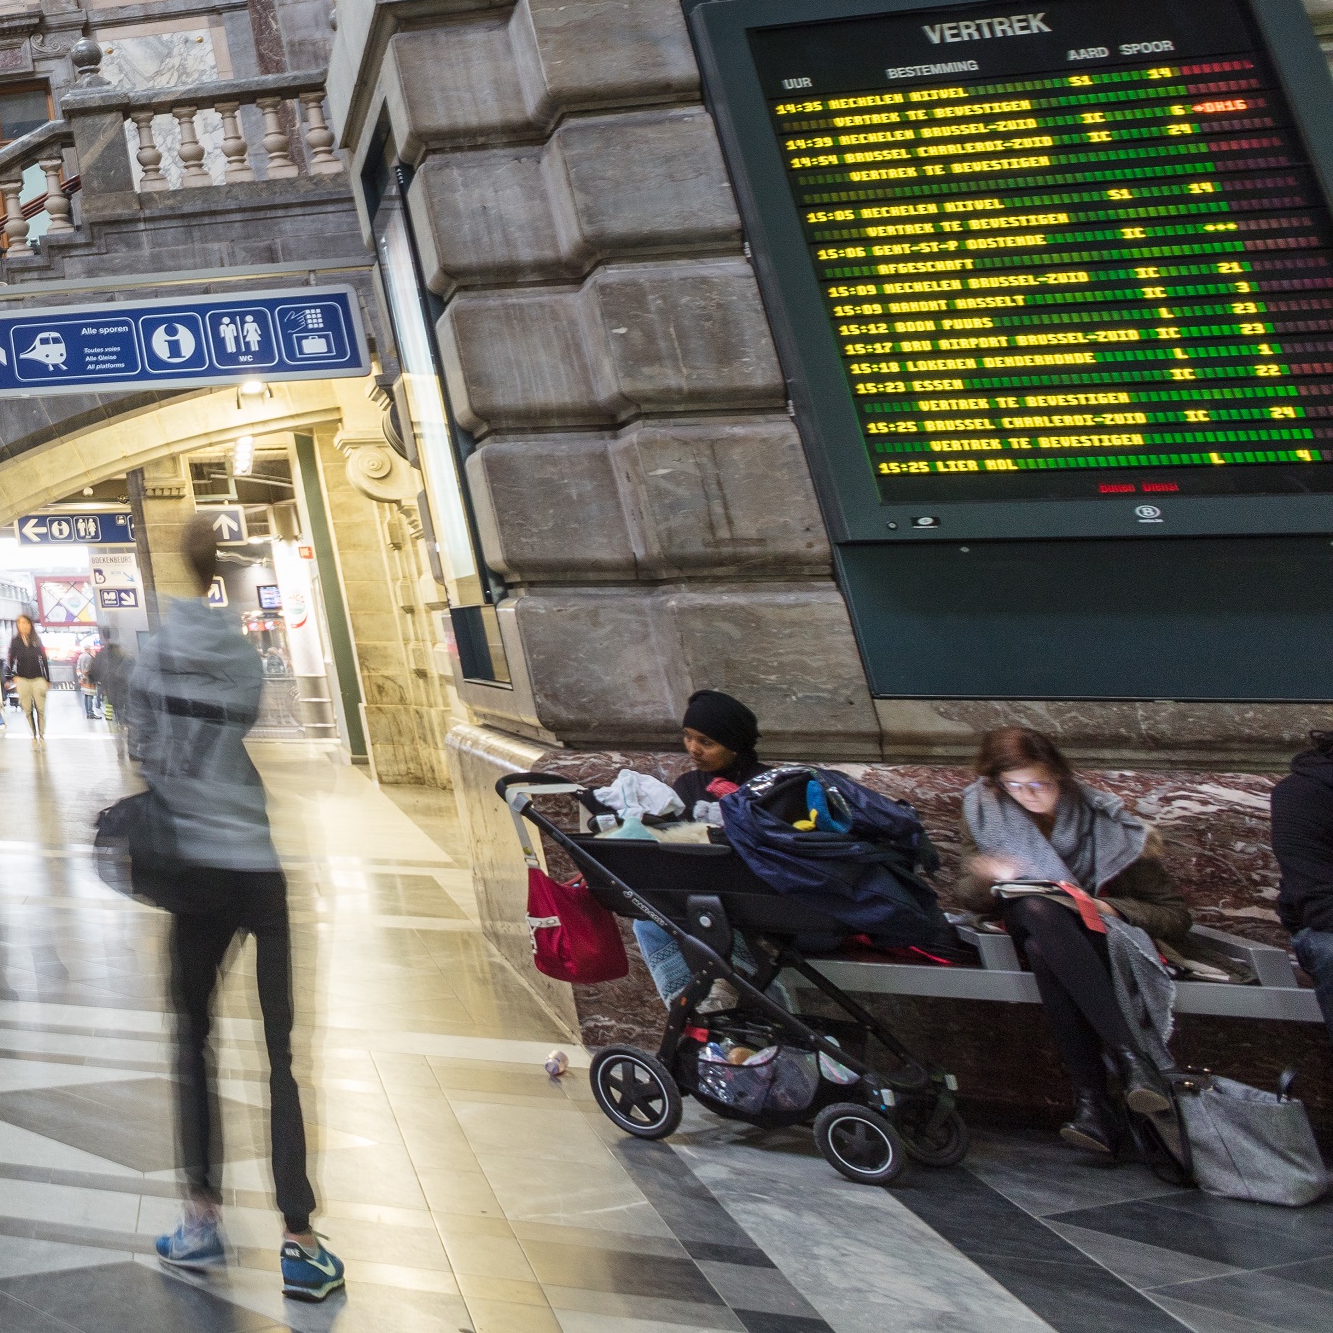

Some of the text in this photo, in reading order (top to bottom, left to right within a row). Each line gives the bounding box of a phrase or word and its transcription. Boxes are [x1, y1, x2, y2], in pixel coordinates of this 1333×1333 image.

[923, 13, 1053, 44] VERTREK
[782, 40, 1175, 90] UUR BESTEMMING AARD SPOOR
[776, 101, 822, 114] 14:35
[828, 94, 904, 109] MECHELEN
[1069, 76, 1093, 86] S1
[1148, 68, 1172, 78] 14
[833, 100, 1031, 127] VERTREK TE BEVESTIGEN
[786, 137, 833, 149] 14:39
[839, 130, 915, 145] MECHELEN
[920, 119, 1037, 138] BRUSSEL-ZUID
[1081, 113, 1105, 123] IC
[1171, 106, 1185, 115] 6
[791, 124, 1192, 167] 14:54 BRUSSEL CHARLEROI-ZUID IC 24
[850, 156, 1050, 181] VERTREK TE BEVESTIGEN
[807, 210, 854, 222] 15:05
[861, 204, 938, 218] MECHELEN
[1108, 189, 1132, 199] S1
[1189, 182, 1214, 193] 14
[866, 213, 1069, 236] VERTREK TE BEVESTIGEN
[818, 228, 1146, 259] 15:06 GENT-ST-P OOSTENDE IC
[829, 262, 1243, 297] 15:09 MECHELEN BRUSSEL-ZUID IC 21
[877, 259, 973, 274] AFGESCHAFT
[834, 304, 882, 316] 15:09
[955, 296, 1024, 309] HASSELT
[1141, 287, 1167, 298] IC
[1235, 282, 1250, 292] 3
[81, 326, 129, 336] Alle sporen
[840, 303, 1257, 335] 15:12 BOOM PUURS L 23
[845, 323, 1265, 354] 15:17 BRU AIRPORT BRUSSEL-ZUID IC 23
[96, 362, 126, 370] platforms
[238, 354, 254, 363] WC
[850, 362, 900, 374] 15:18
[906, 359, 976, 371] LOKEREN
[1173, 348, 1188, 359] L
[1258, 344, 1273, 354] 1
[856, 365, 1281, 393] 15:23 ESSEN IC 22
[918, 393, 1130, 411] VERTREK TE BEVESTIGEN
[867, 407, 1296, 433] 15:25 BRUSSEL CHARLEROI-ZUID IC 24
[930, 434, 1144, 451] VERTREK TE BEVESTIGEN
[879, 450, 1311, 473] 15:25 LIER MOL L 4
[91, 556, 132, 564] BOEKENBEURS
[284, 1248, 301, 1258] NIKE
